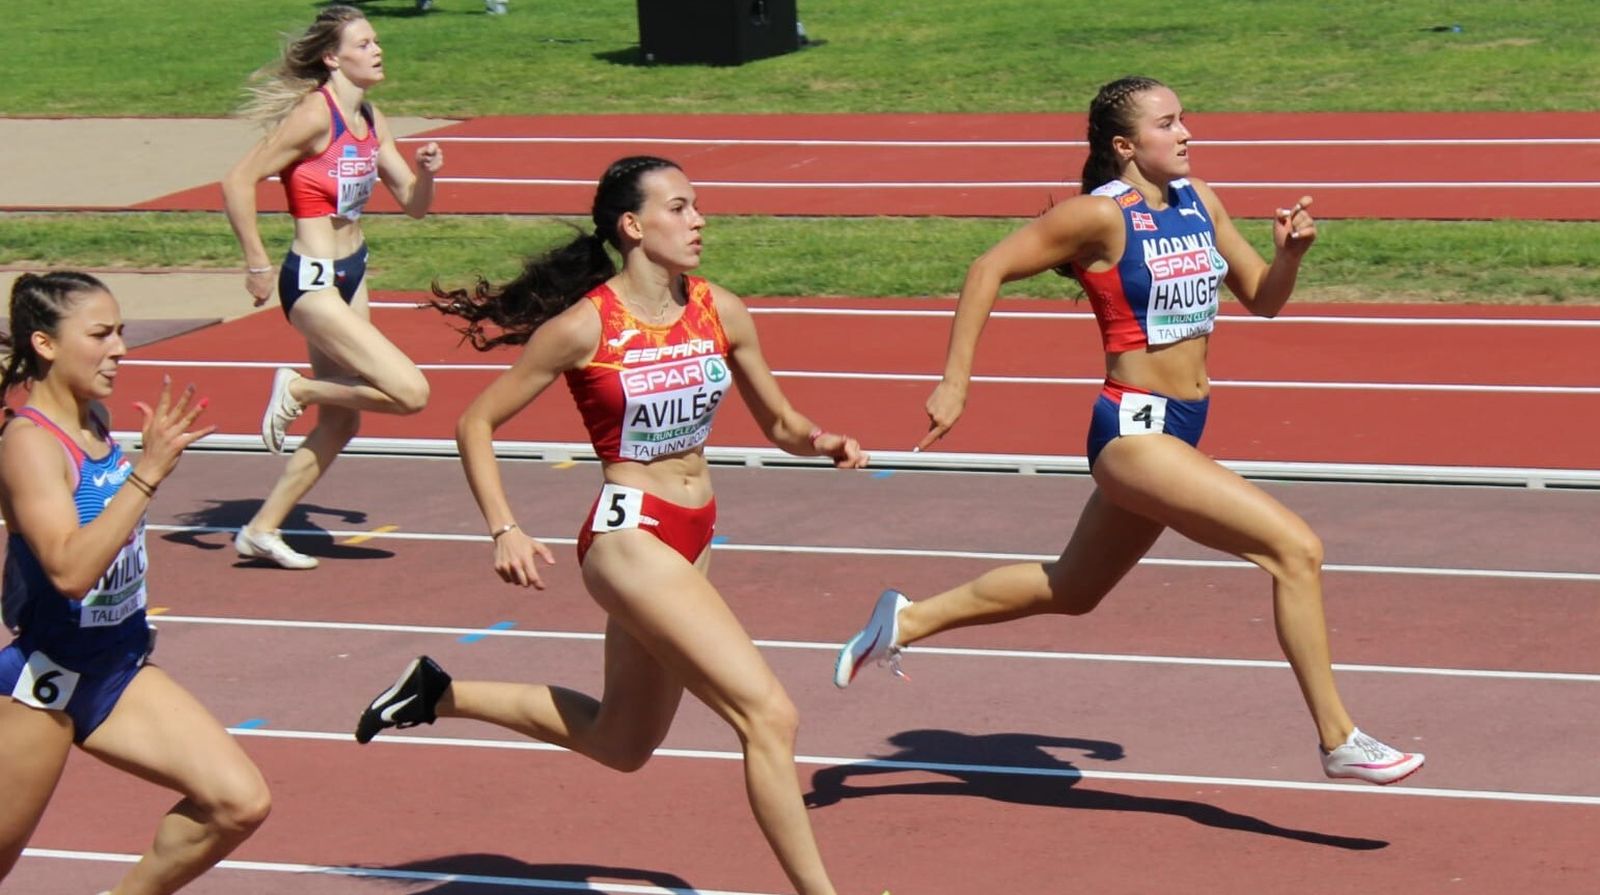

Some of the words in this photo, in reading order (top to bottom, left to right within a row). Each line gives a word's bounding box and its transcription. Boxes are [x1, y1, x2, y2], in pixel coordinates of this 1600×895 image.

[311, 262, 325, 285] 2
[1152, 252, 1210, 278] SPAR
[624, 340, 713, 363] ESPAÑA
[628, 371, 702, 393] SPAR
[630, 386, 723, 428] AVILÉS
[1132, 404, 1152, 429] 4
[652, 429, 673, 441] RUN
[631, 438, 686, 459] TALLINN
[606, 493, 626, 527] 5
[33, 671, 63, 704] 6
